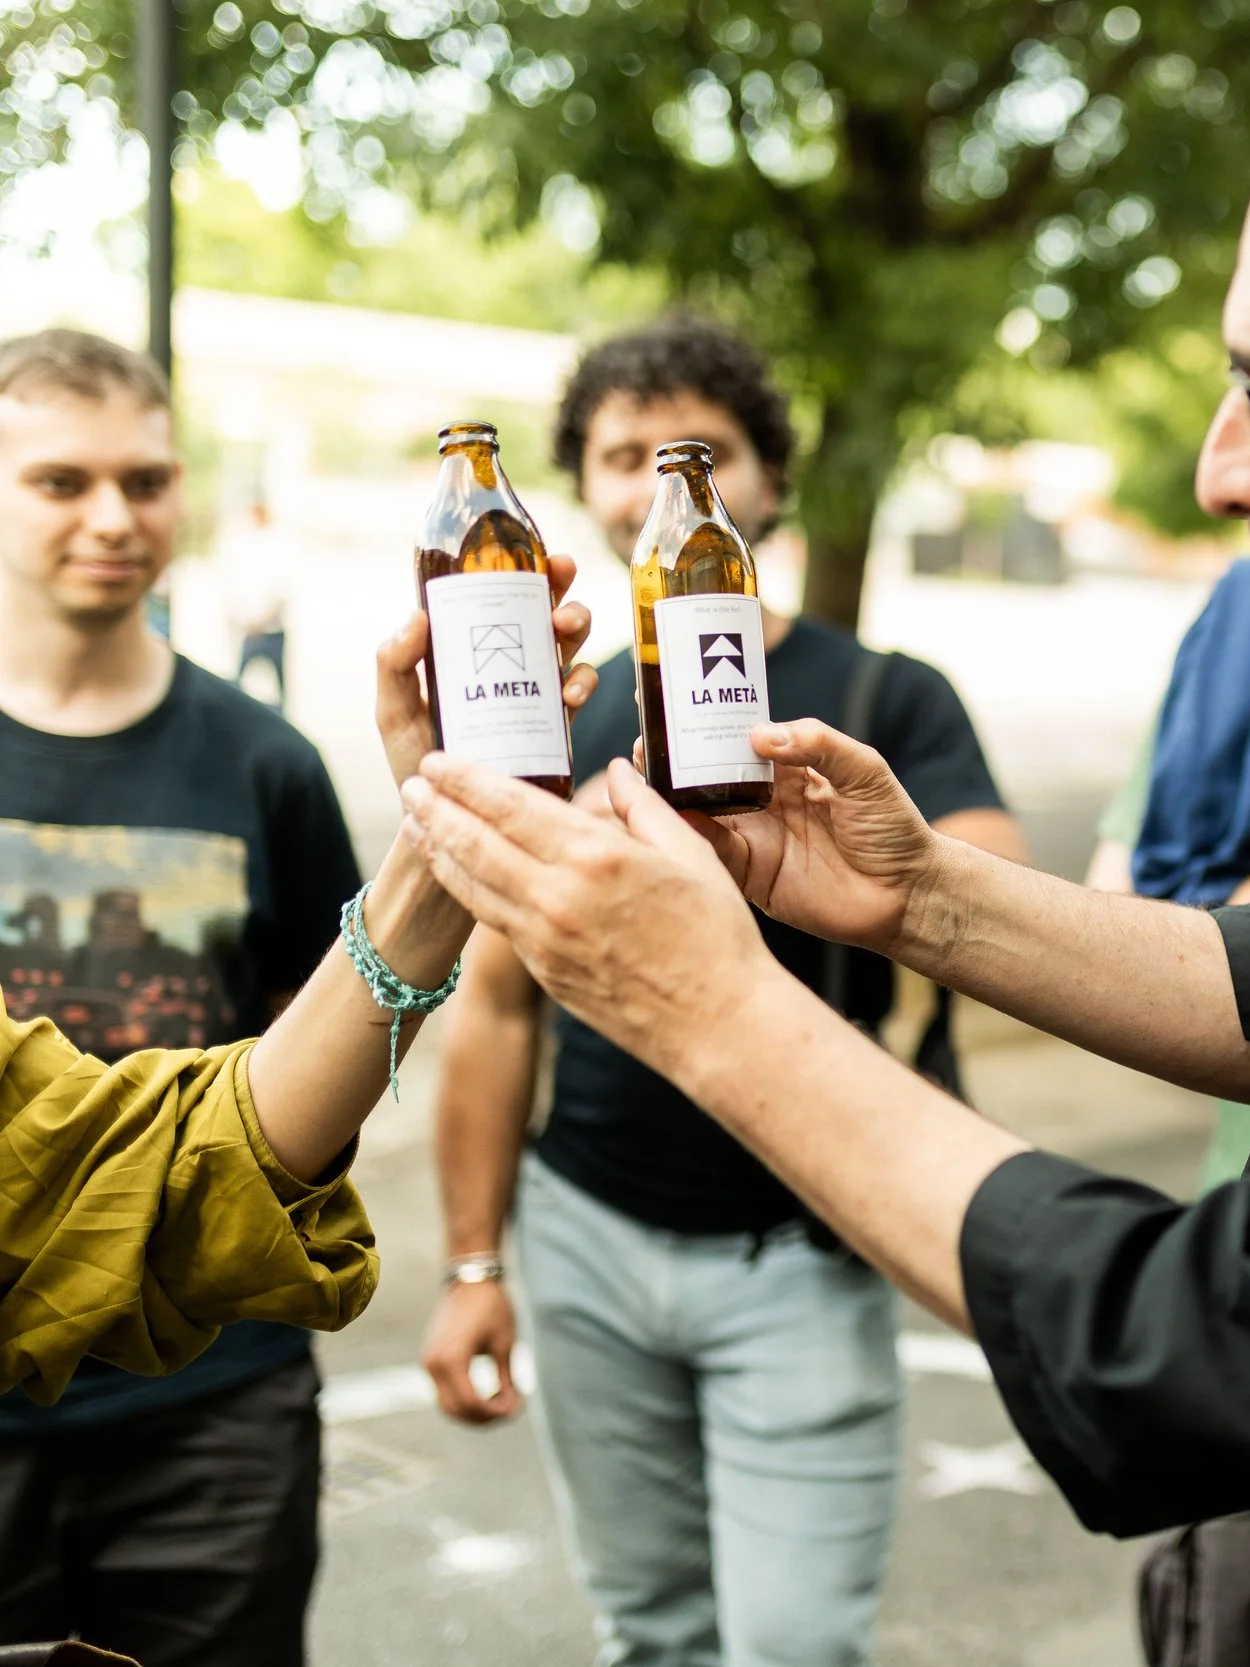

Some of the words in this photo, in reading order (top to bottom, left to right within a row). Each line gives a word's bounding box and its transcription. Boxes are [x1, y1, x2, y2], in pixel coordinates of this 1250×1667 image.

[465, 684, 486, 701] LA
[494, 681, 541, 698] META
[692, 689, 713, 705] LA
[719, 683, 758, 703] METÀ
